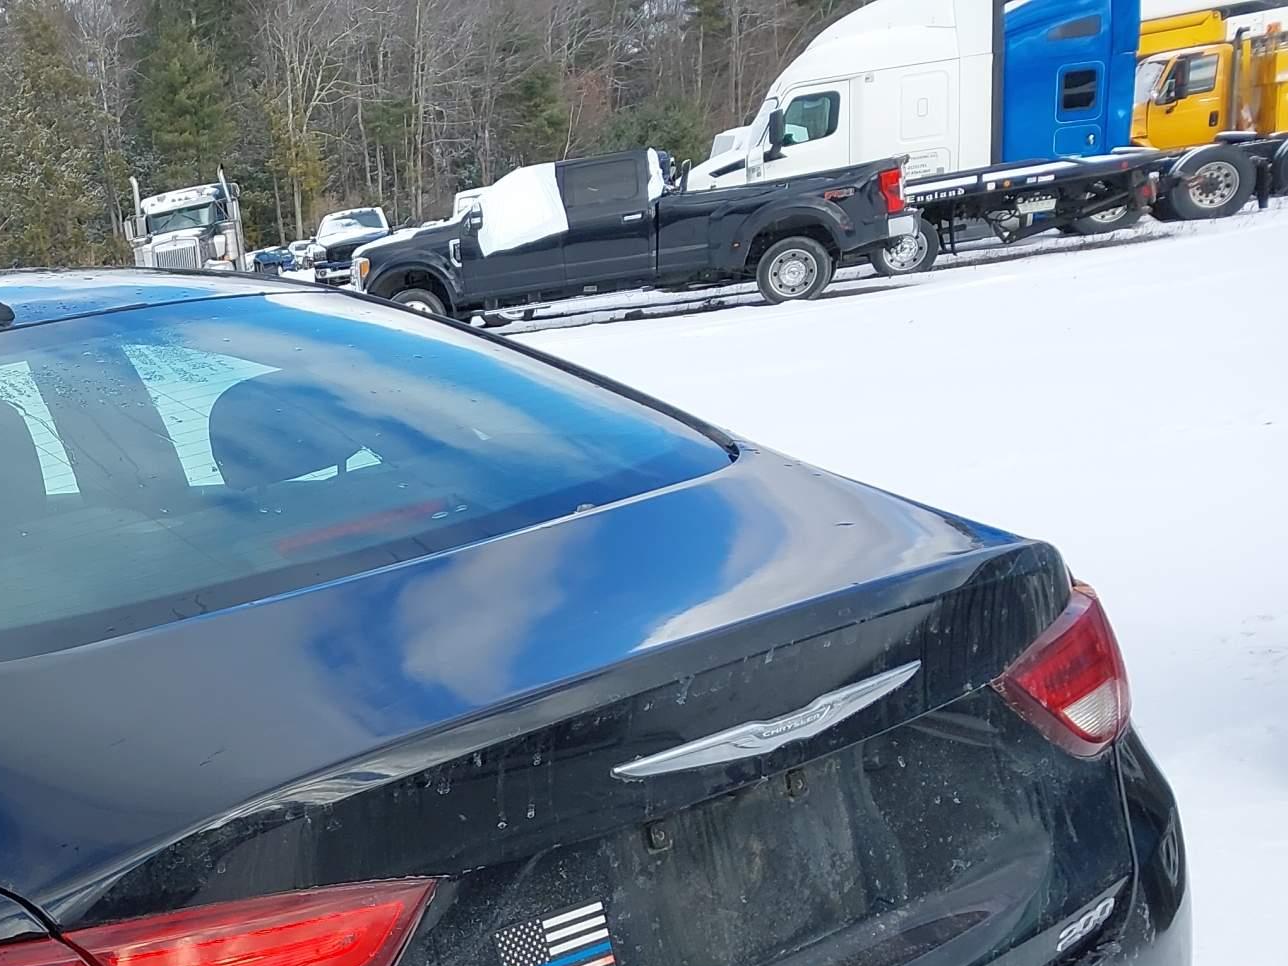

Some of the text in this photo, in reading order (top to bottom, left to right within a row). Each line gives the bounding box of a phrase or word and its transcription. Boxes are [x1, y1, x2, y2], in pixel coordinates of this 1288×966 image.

[906, 188, 965, 203] England
[762, 713, 822, 738] CHRYSLER
[1056, 897, 1115, 952] 200
